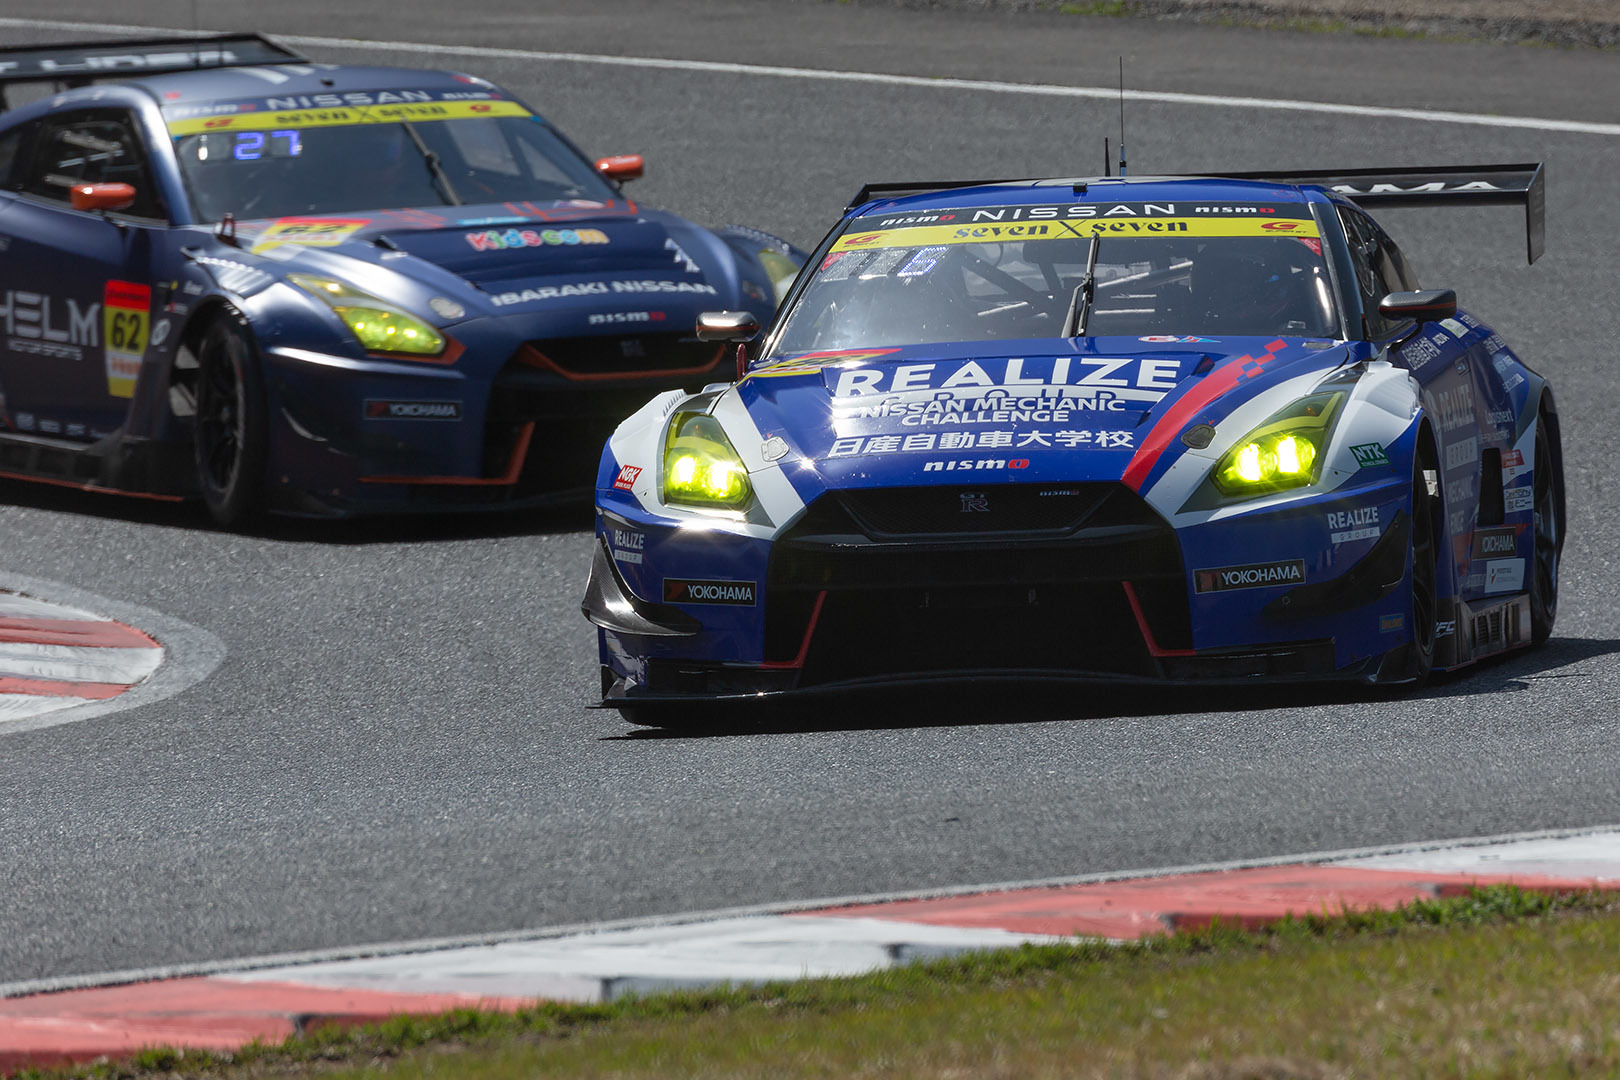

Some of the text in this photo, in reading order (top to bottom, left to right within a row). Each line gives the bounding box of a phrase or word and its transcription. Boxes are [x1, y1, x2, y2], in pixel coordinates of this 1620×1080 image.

[266, 90, 433, 111] NISSAN
[234, 130, 300, 160] 27
[972, 204, 1175, 222] NISSAN
[1195, 206, 1276, 214] nismo
[880, 213, 957, 227] nismo
[491, 280, 718, 306] IBARAKI NISSAN
[588, 312, 666, 325] nismo
[112, 311, 142, 351] 62
[834, 358, 1181, 398] REALIZE
[860, 397, 1127, 419] NISSAN MECHANIC
[901, 410, 1070, 426] CHALLENGE
[827, 430, 1134, 459] 日産自動車大学校
[1351, 444, 1385, 461] NTK
[617, 466, 640, 483] NGK
[923, 459, 1031, 472] nismo
[1328, 507, 1379, 529] REALIZE
[614, 530, 645, 550] REALIZE
[1340, 530, 1375, 541] GROUP
[1221, 565, 1301, 585] YOKOHAMA
[687, 585, 753, 601] YOKOHAMA
